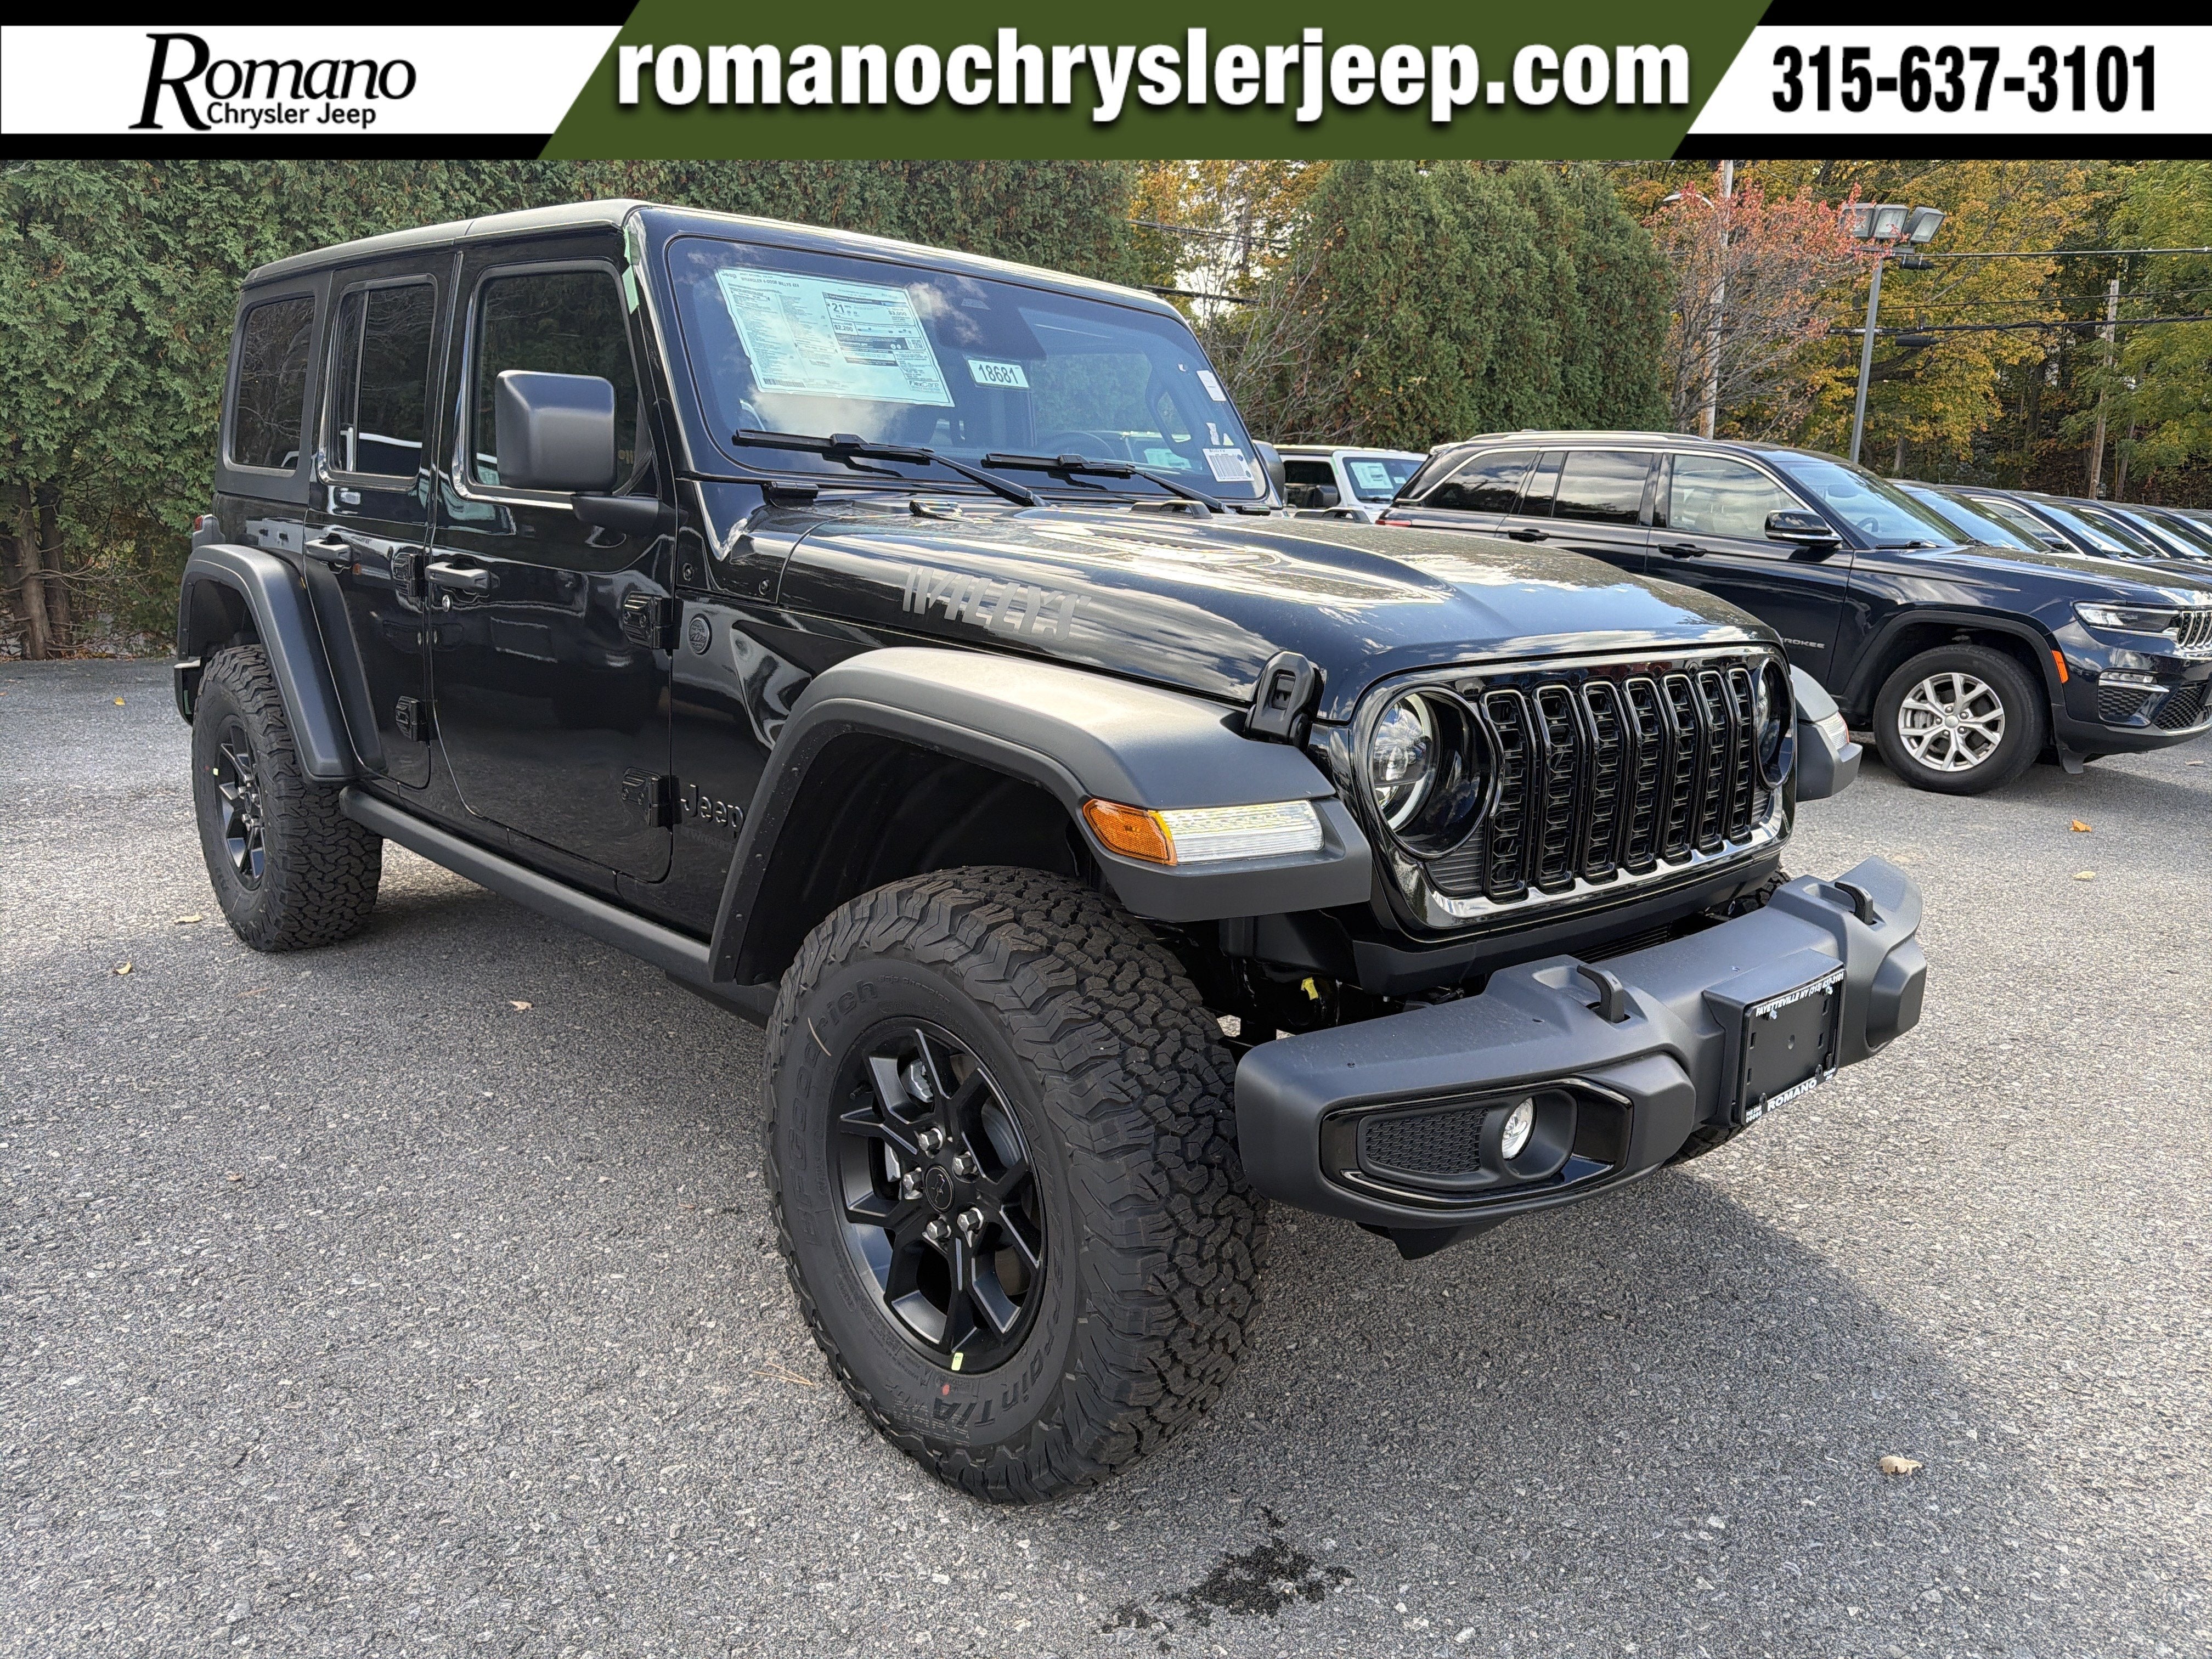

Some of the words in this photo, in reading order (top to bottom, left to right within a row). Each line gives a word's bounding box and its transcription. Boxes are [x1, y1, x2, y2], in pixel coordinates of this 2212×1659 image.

[832, 303, 844, 313] 21
[979, 364, 1018, 384] 18681
[902, 566, 1092, 641] WILLYS
[1782, 637, 1825, 649] ROKEE
[680, 784, 744, 839] Jeep
[1756, 992, 1799, 1017] FAYETTEVILLE
[1767, 1079, 1817, 1112] ROMANO
[788, 979, 877, 1246] BFGoodrich
